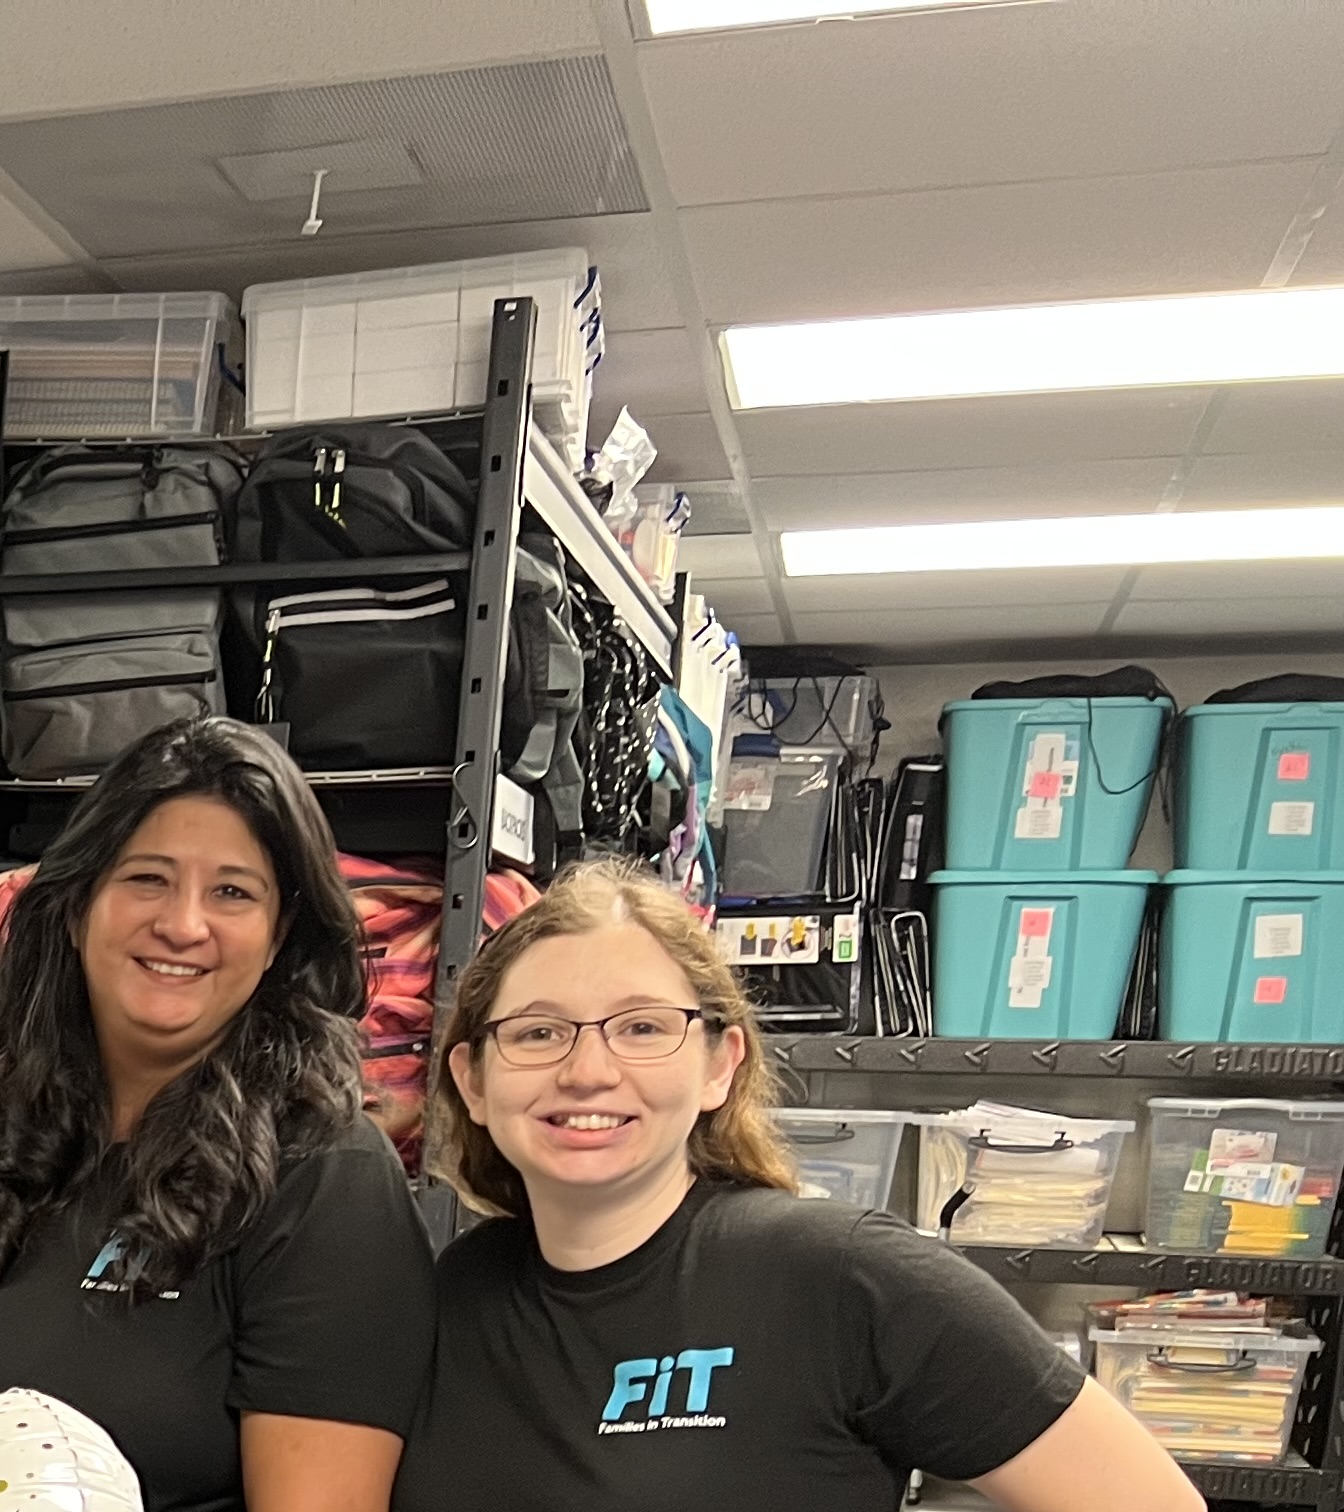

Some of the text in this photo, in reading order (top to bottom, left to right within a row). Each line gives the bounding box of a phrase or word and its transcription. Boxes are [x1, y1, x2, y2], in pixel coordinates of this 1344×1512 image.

[597, 1413, 727, 1435] Families in Transition
